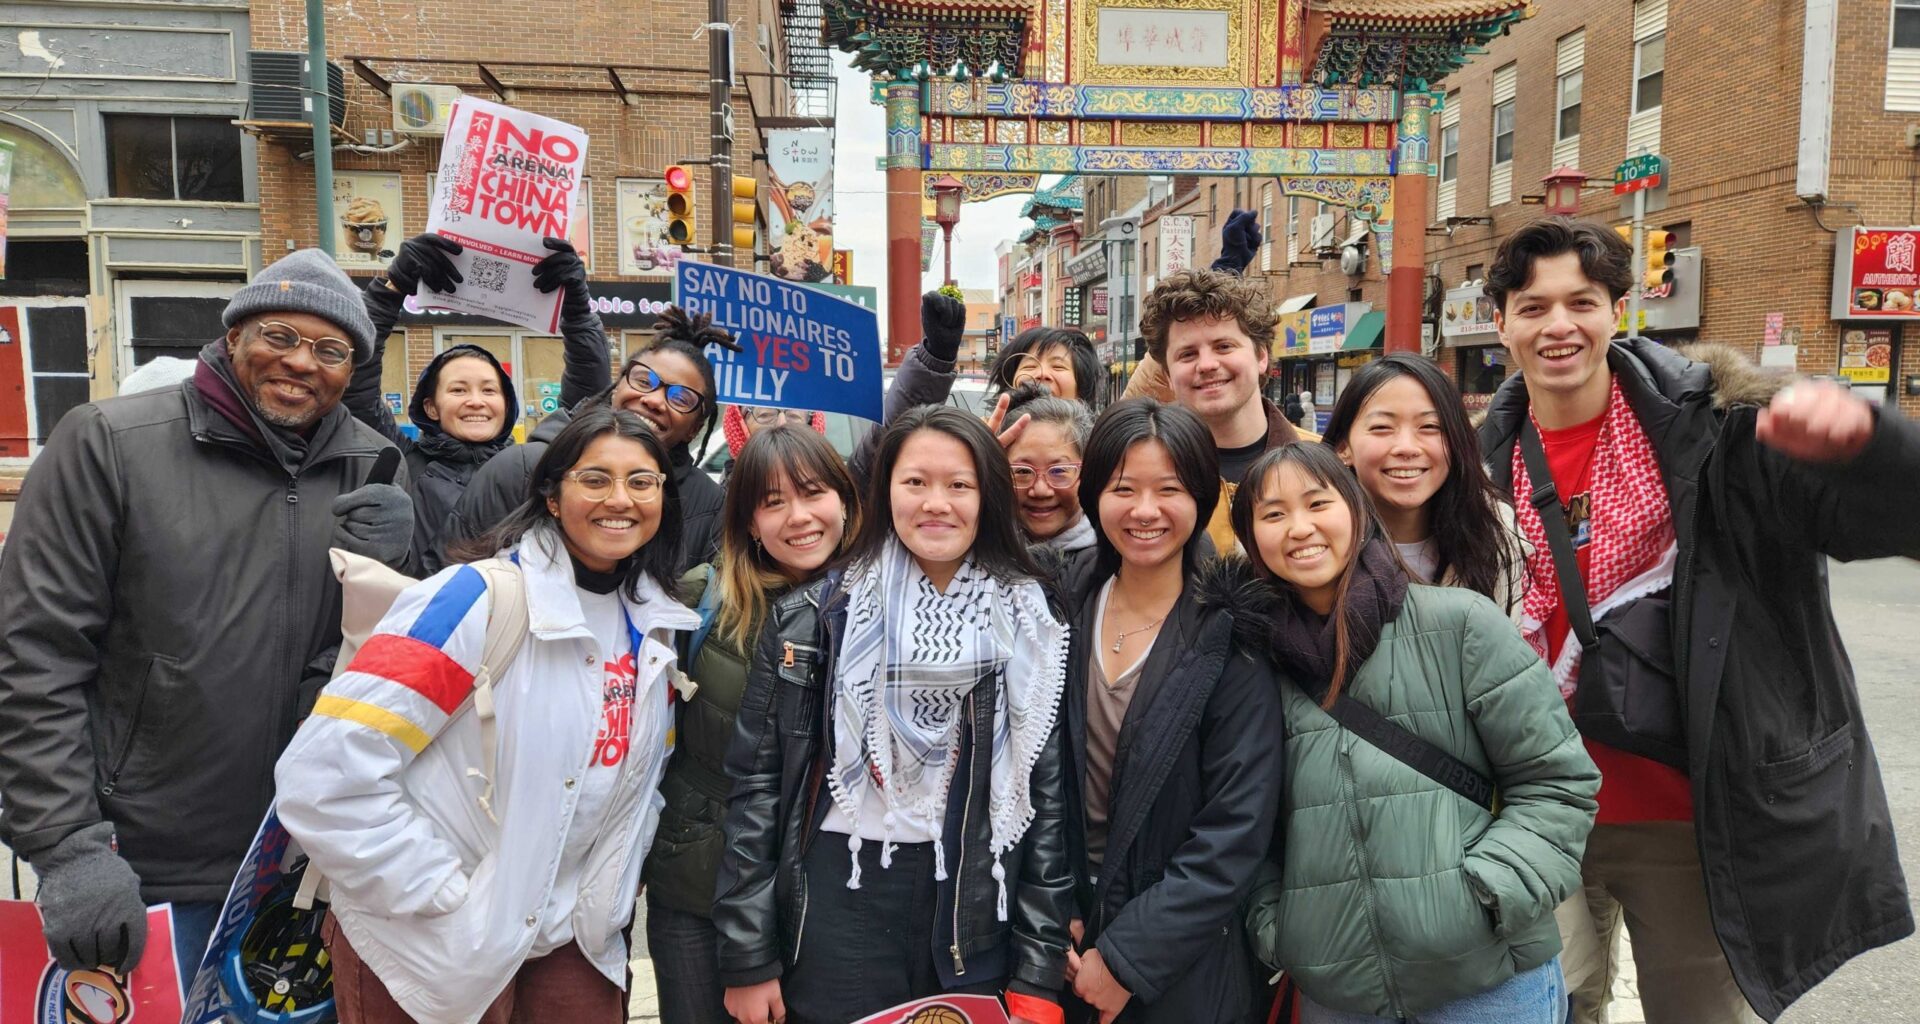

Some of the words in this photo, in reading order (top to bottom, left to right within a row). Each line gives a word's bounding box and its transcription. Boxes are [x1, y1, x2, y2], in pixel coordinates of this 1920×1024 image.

[495, 118, 579, 163] NO
[492, 153, 568, 180] ARENA
[1649, 164, 1659, 174] ST
[479, 193, 568, 240] TOWN
[481, 171, 568, 217] CHINA
[443, 233, 457, 242] GET
[458, 237, 493, 252] INVOLVED
[500, 248, 522, 259] LEARN
[523, 256, 541, 264] MOR
[684, 267, 729, 297] SAY
[738, 277, 771, 306] NO
[777, 286, 807, 315] TO
[1862, 273, 1917, 285] AUTHENTIC
[752, 333, 810, 372] YES
[818, 347, 855, 382] TO
